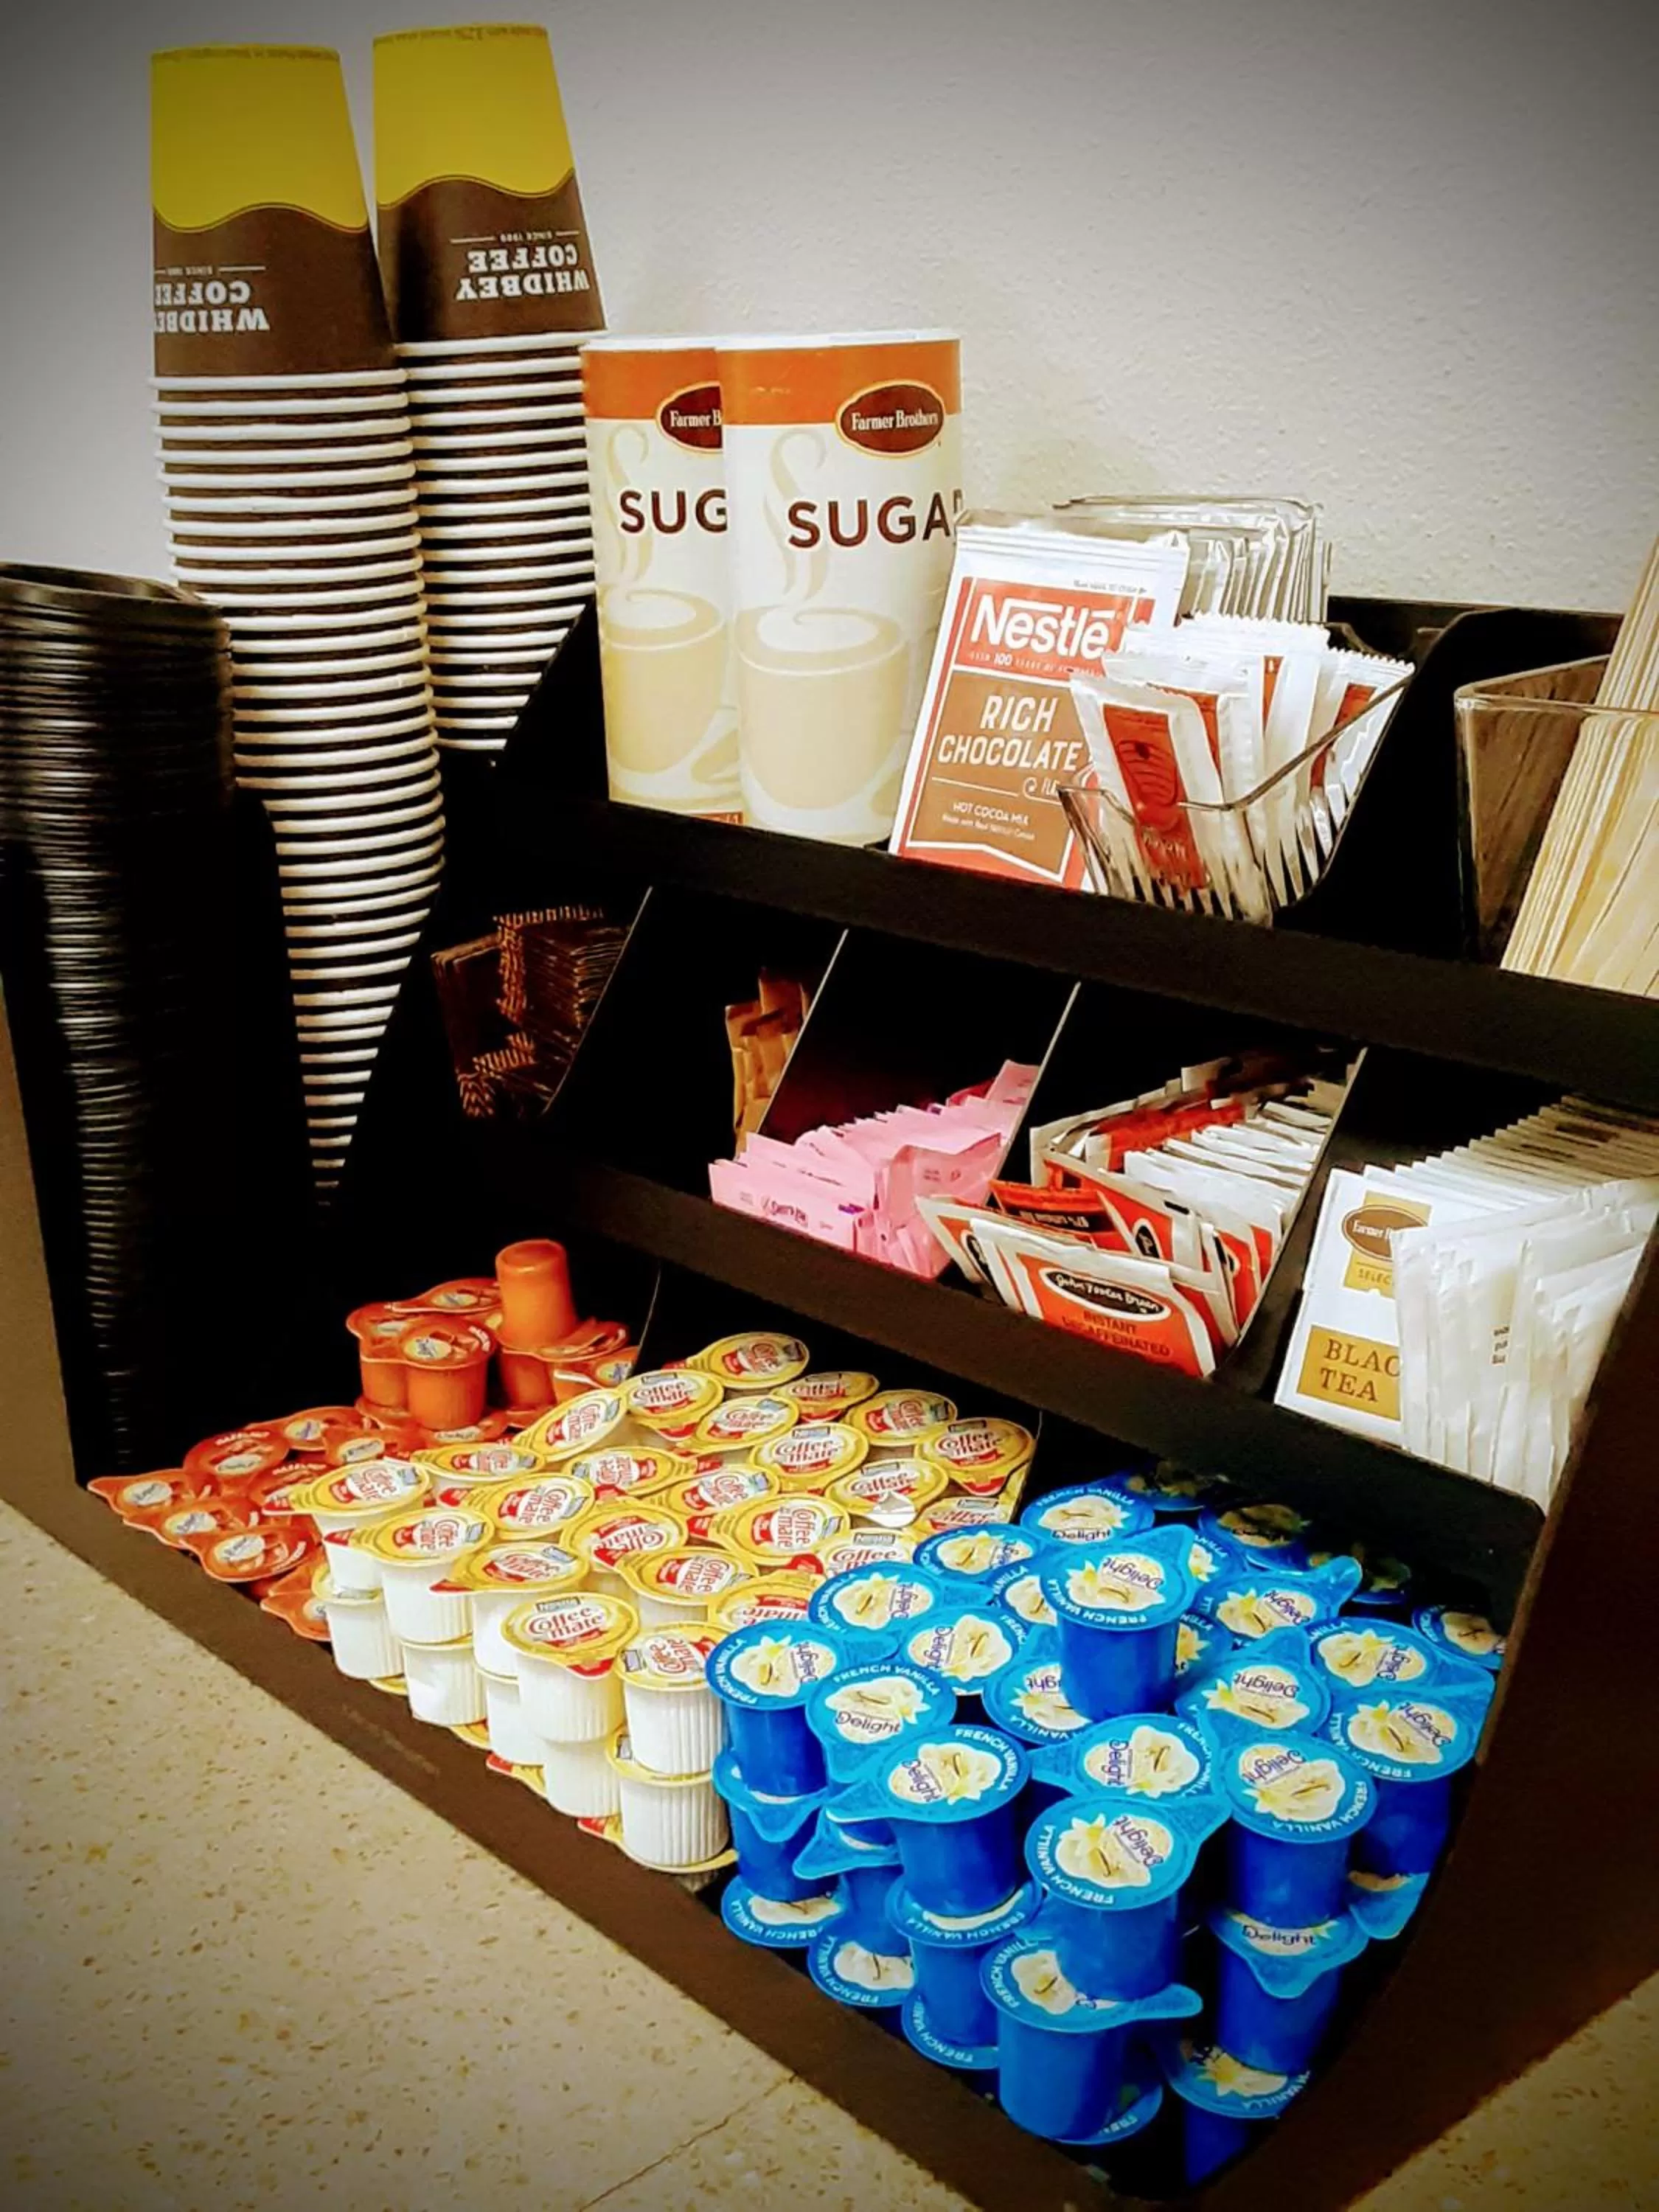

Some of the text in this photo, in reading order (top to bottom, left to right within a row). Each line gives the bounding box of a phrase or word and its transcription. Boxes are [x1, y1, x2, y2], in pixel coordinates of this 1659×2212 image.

[467, 245, 578, 273] COFFEE
[456, 269, 591, 302] WHIDBEY
[154, 308, 271, 333] WHIDBE
[669, 410, 712, 428] Farmer
[852, 409, 939, 431] Farmer Brothers
[619, 489, 727, 533] SUG
[980, 695, 1058, 733] RICH
[938, 734, 1082, 772] CHOCOLATE
[953, 801, 1029, 826] HOT COCOA MIX
[1358, 1267, 1393, 1286] SELEC
[1083, 1310, 1138, 1335] INSTANT
[1324, 1338, 1401, 1377] BLAC
[633, 1382, 686, 1400] Coffee
[1320, 1368, 1379, 1402] TEA
[775, 1439, 835, 1457] Coffee
[935, 1432, 995, 1453] Coffee
[955, 1438, 1004, 1458] mate
[518, 1492, 541, 1524] mate
[537, 1486, 568, 1523] Coffee
[777, 1509, 793, 1548] mate
[793, 1507, 816, 1546] Coffee
[1050, 1527, 1112, 1541] Delight
[832, 1549, 897, 1568] Coffee
[1102, 1557, 1164, 1590] Delight
[678, 1562, 704, 1594] mate
[698, 1558, 730, 1594] Coffee
[891, 1582, 918, 1620] Delight
[1080, 1607, 1148, 1624] FRENCH
[529, 1607, 592, 1635] Coffee
[547, 1615, 604, 1641] mate
[1001, 1615, 1026, 1646] FRENC
[923, 1626, 954, 1671] Delight
[832, 1663, 942, 1697] FRENCH VANILLA
[1234, 1671, 1300, 1699] Delight
[835, 1710, 901, 1734] Delight
[1011, 1714, 1069, 1739] VANILLA
[1399, 1703, 1452, 1747] Delight
[955, 1728, 1008, 1753] FRENCH
[1101, 1739, 1129, 1787] Delight
[1242, 1749, 1307, 1786] Delight
[900, 1759, 942, 1804] Delight
[1271, 1780, 1368, 1834] FRENCH VANILLA
[1112, 1815, 1164, 1867] Delight
[1036, 1825, 1115, 1905] FRENCH VANILLA
[906, 1913, 1026, 1941] FRENCH VANILLA
[1241, 1924, 1317, 1947] Delight
[990, 1938, 1040, 2008] FRENCH VANILL
[827, 1979, 880, 2005] FRENCH
[925, 2031, 974, 2063] FRENCH
